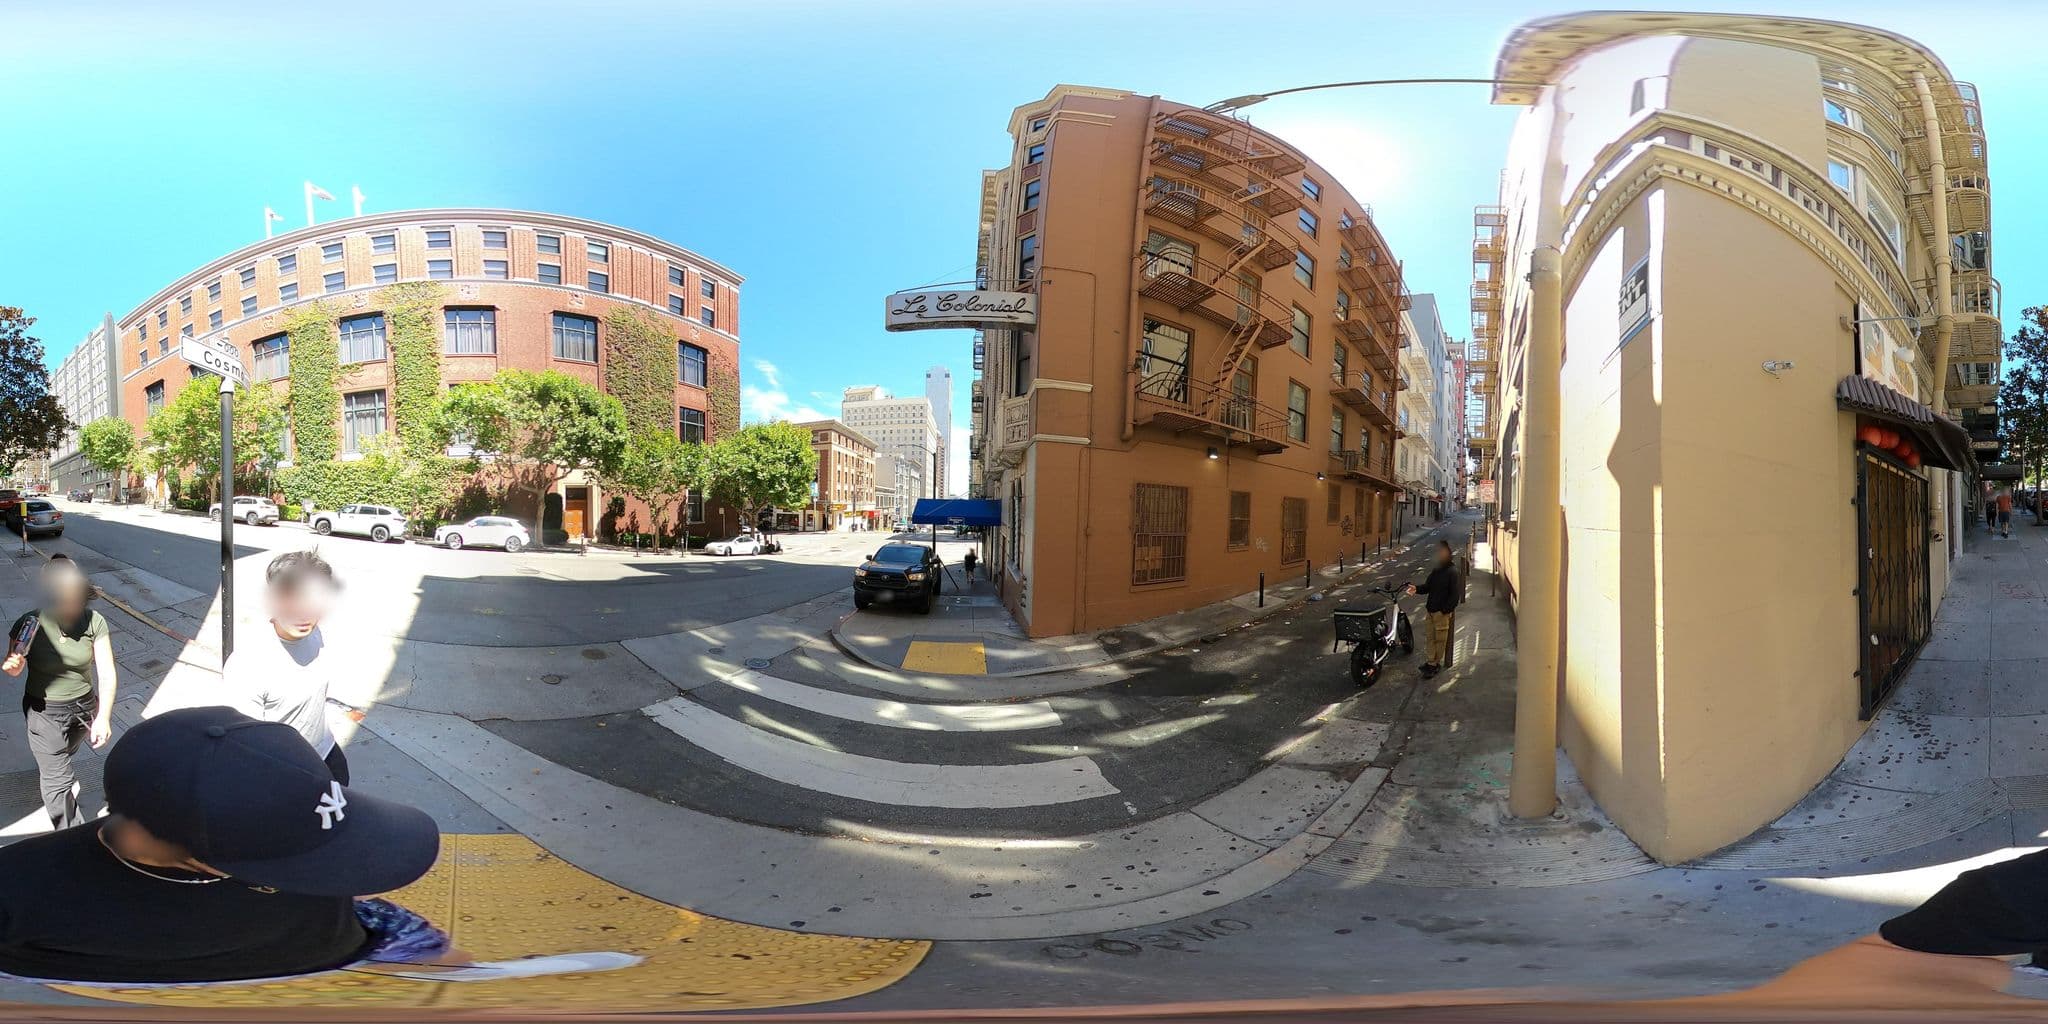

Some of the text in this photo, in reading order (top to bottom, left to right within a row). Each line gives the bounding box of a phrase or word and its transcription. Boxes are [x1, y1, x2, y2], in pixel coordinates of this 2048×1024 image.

[892, 293, 1034, 315] Le Colonial
[1040, 918, 1253, 959] COSMO
